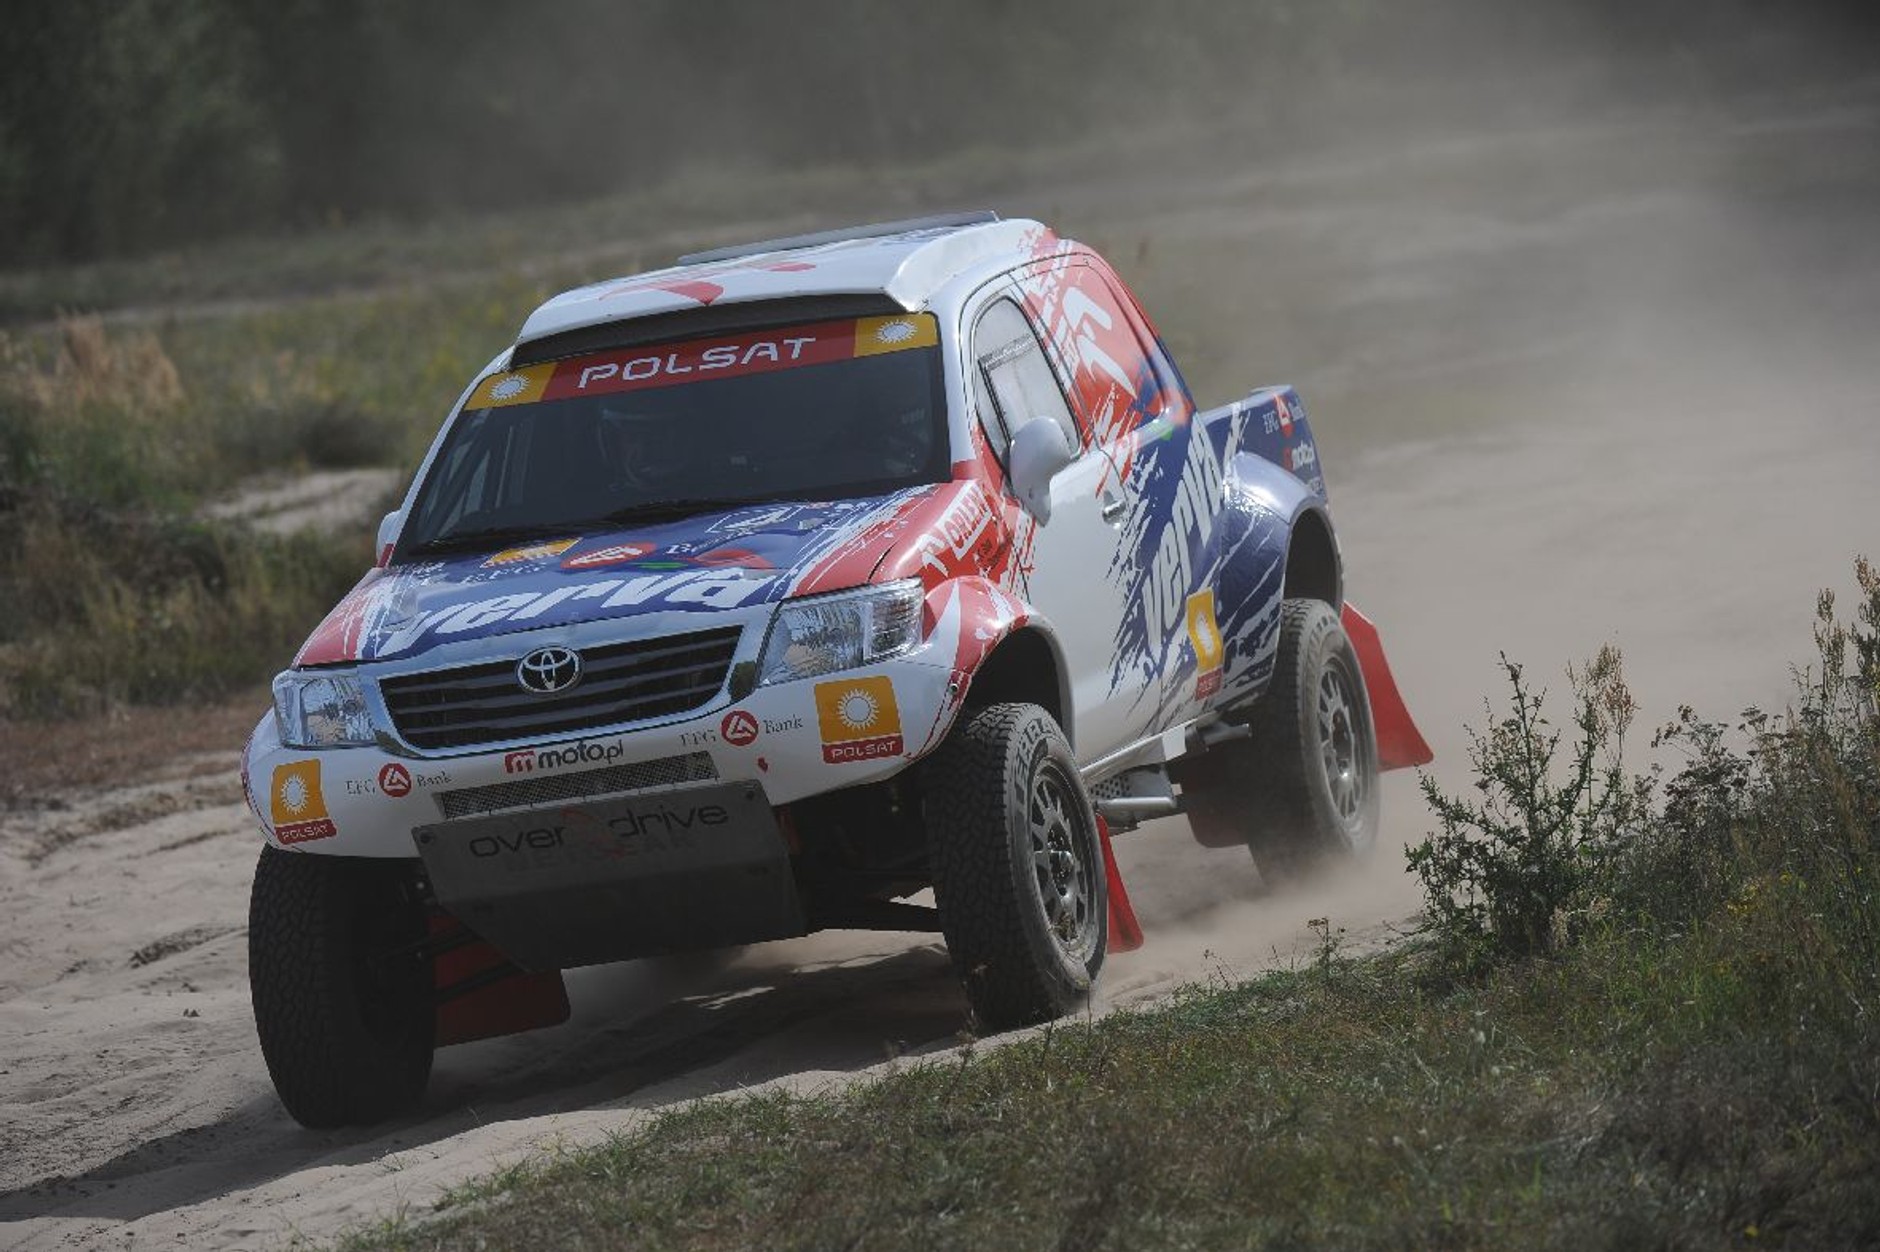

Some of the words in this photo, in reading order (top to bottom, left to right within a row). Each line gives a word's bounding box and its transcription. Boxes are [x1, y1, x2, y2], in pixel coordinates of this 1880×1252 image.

[577, 335, 817, 389] POLSAT
[376, 567, 778, 659] verva
[762, 714, 804, 735] Bank
[537, 739, 624, 769] moto.pl
[831, 740, 897, 759] POLSAT
[281, 823, 329, 843] POLSAT
[469, 823, 568, 858] over
[606, 804, 730, 838] drive
